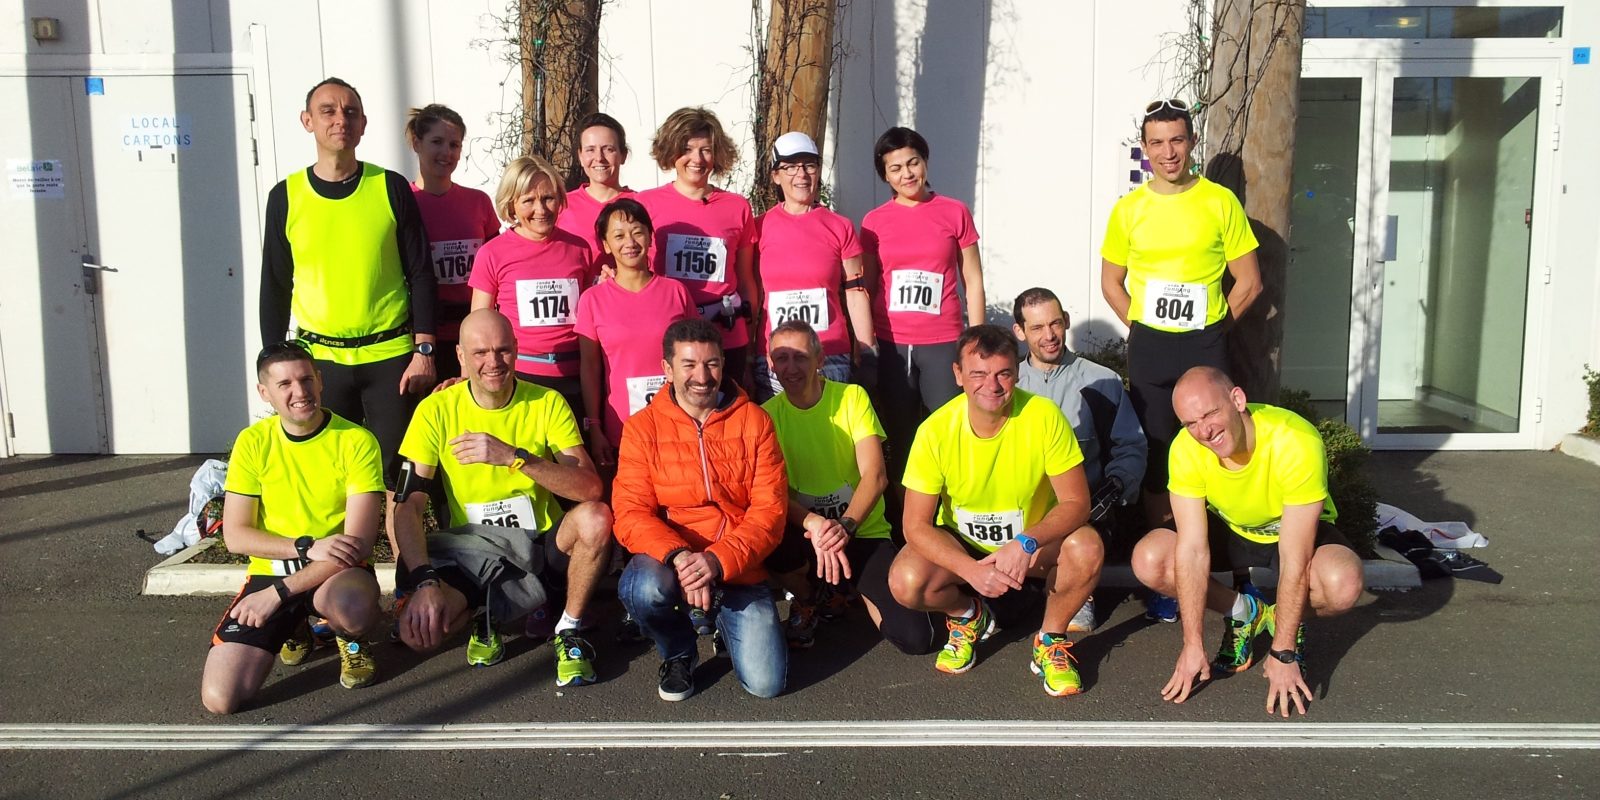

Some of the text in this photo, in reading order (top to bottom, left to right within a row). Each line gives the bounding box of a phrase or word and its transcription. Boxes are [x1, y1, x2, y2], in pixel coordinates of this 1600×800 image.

[131, 117, 180, 129] LOCAL
[123, 134, 191, 146] CARTONS
[673, 250, 718, 275] 1156
[529, 295, 571, 319] 1174
[898, 285, 933, 307] 1170
[1155, 297, 1195, 322] 804
[964, 523, 1014, 542] 1381
